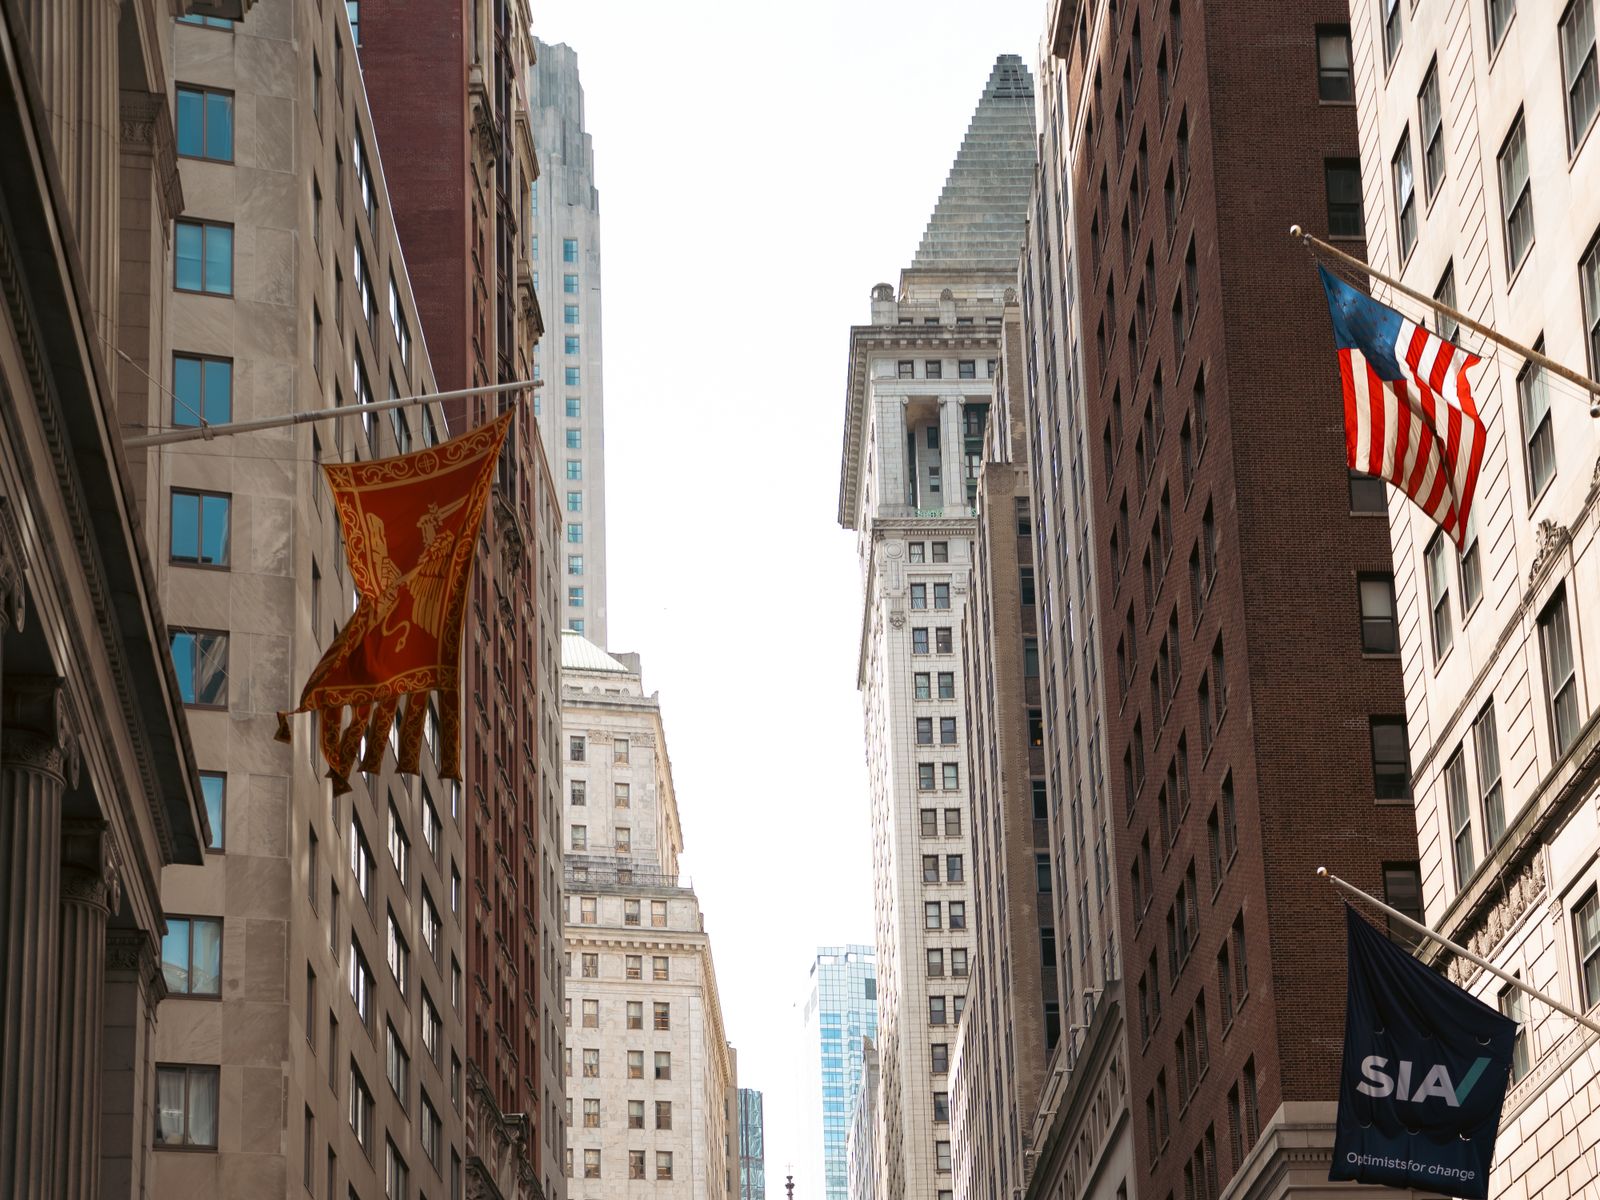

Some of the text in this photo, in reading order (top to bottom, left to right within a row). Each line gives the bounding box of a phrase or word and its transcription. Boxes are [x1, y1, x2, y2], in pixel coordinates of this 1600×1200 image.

[1347, 1152, 1476, 1181] Optimists for change
